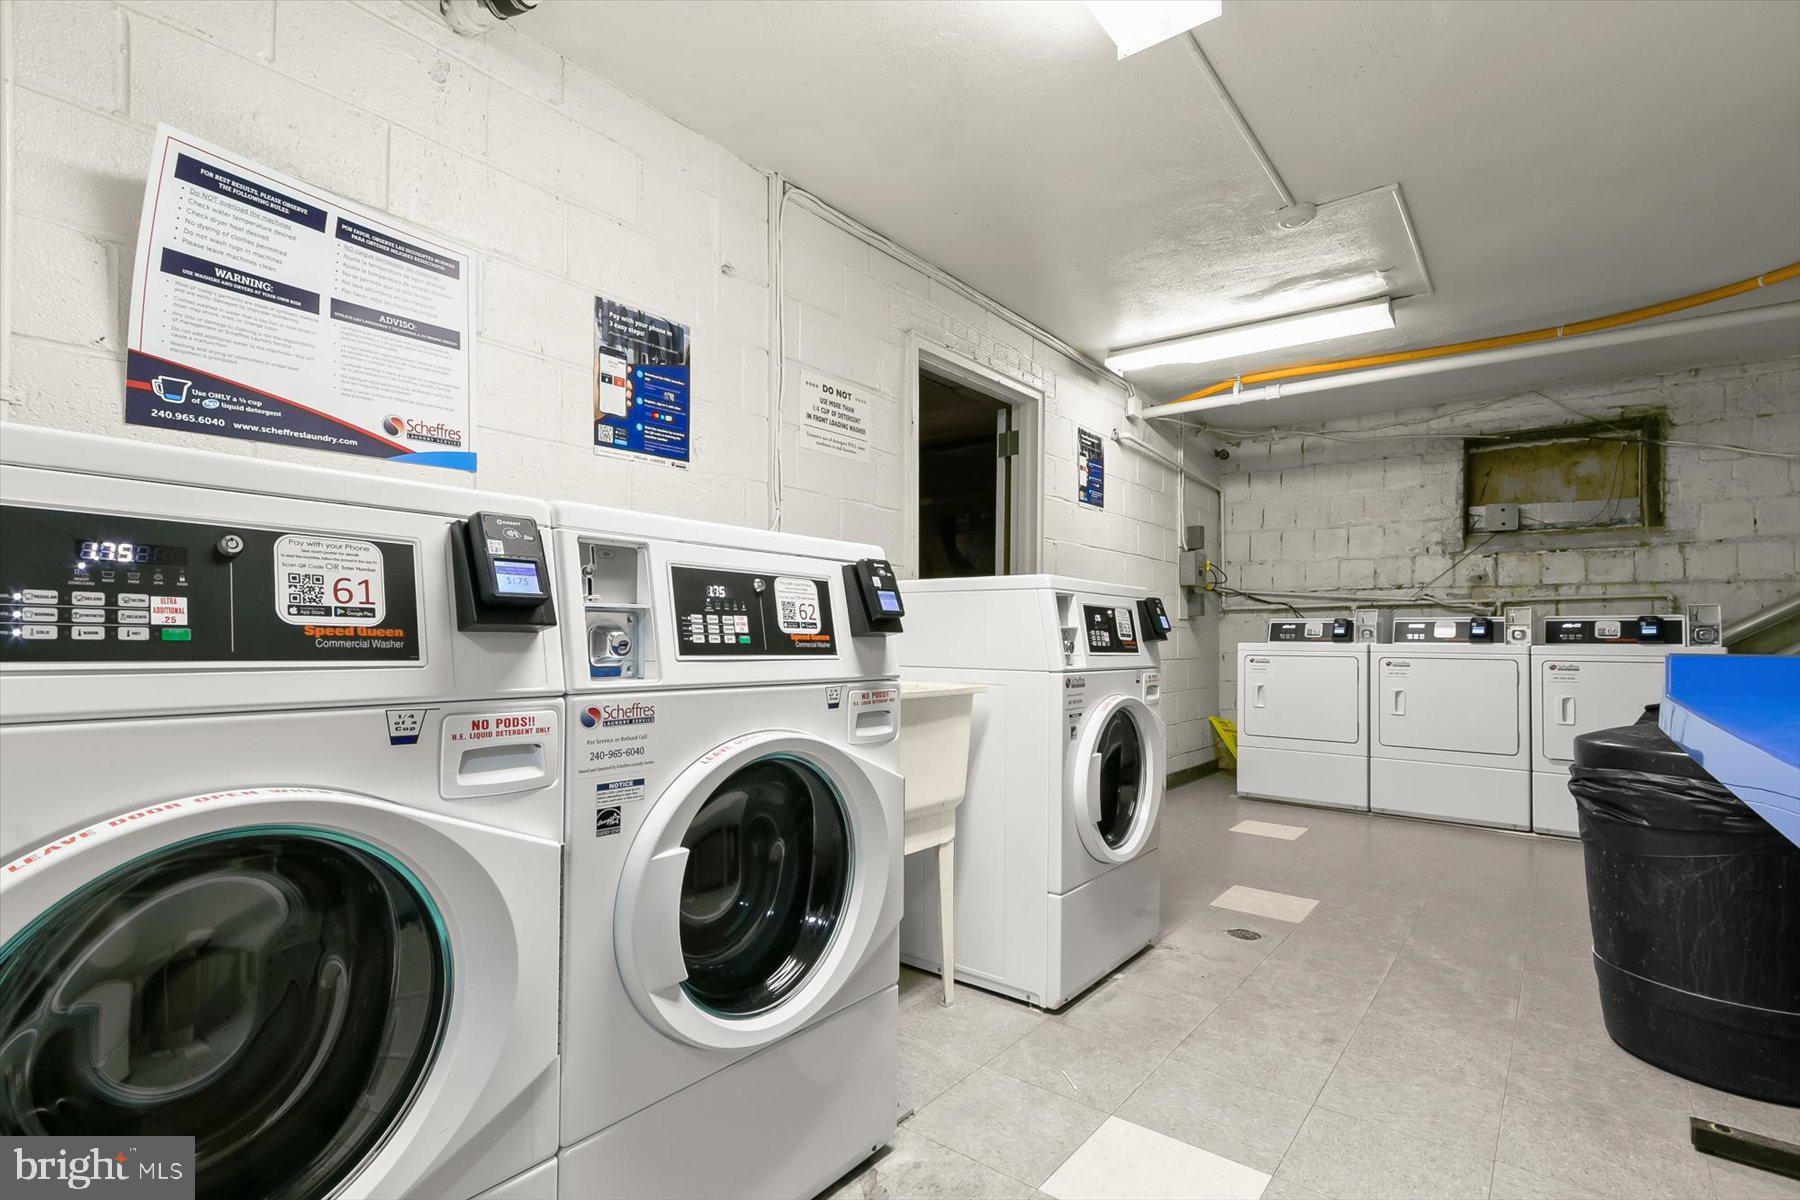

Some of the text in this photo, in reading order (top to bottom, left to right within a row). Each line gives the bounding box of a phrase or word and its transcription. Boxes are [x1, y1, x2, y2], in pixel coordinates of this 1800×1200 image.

[200, 168, 214, 178] FOR
[215, 174, 230, 184] BEST
[260, 192, 281, 204] PLEASE
[282, 201, 308, 215] OBSERVE
[218, 182, 232, 192] THE
[232, 188, 269, 206] FOLLOWING
[190, 188, 291, 230] Do NOT overload the machines
[187, 208, 269, 241] Check dryer heat desired
[188, 198, 296, 241] Check water temperature desired
[184, 227, 194, 236] Do
[210, 237, 227, 246] wash
[229, 244, 243, 253] rugs
[252, 251, 283, 265] machines
[185, 218, 195, 226] No
[197, 223, 220, 236] dyeing
[231, 234, 255, 246] clothes
[256, 242, 288, 257] permitted
[182, 237, 277, 272] Please leave machines clean
[214, 267, 273, 292] WARNING:
[380, 315, 417, 331] ADVISO:
[609, 311, 620, 321] Pay
[620, 316, 634, 324] with
[634, 320, 648, 328] your
[648, 324, 666, 335] phone
[614, 322, 627, 333] easy
[192, 388, 206, 398] Use
[208, 392, 231, 401] ONLY
[248, 400, 263, 408] cup
[822, 384, 852, 401] DO NOT
[221, 402, 244, 412] liquid
[245, 406, 282, 417] detergent
[819, 397, 855, 414] USE MORE THAN
[806, 412, 866, 435] IN FRONT LOADING WASHER
[820, 407, 830, 415] CUP
[838, 412, 861, 424] DETERGENT
[150, 408, 358, 446] 240.965.6040 www.scheffreslaundry.com
[406, 418, 461, 441] Scheffres
[288, 539, 305, 547] Pay
[344, 544, 370, 552] Phone
[333, 577, 376, 605] 61
[799, 603, 816, 621] 62
[304, 625, 404, 638] Speed Queen
[315, 638, 404, 648] Commercial Washer
[861, 692, 870, 700] NO
[603, 702, 655, 720] Scheffres
[469, 731, 493, 739] LIQUID
[496, 729, 533, 737] DETERGENT
[536, 726, 551, 734] ONLY
[472, 716, 535, 730] NO PODS!!
[589, 746, 645, 761] 240-965-6040
[609, 781, 634, 789] NOTICE
[8, 827, 98, 873] LEAVE
[108, 803, 183, 827] DOOR
[193, 790, 258, 803] OPEN
